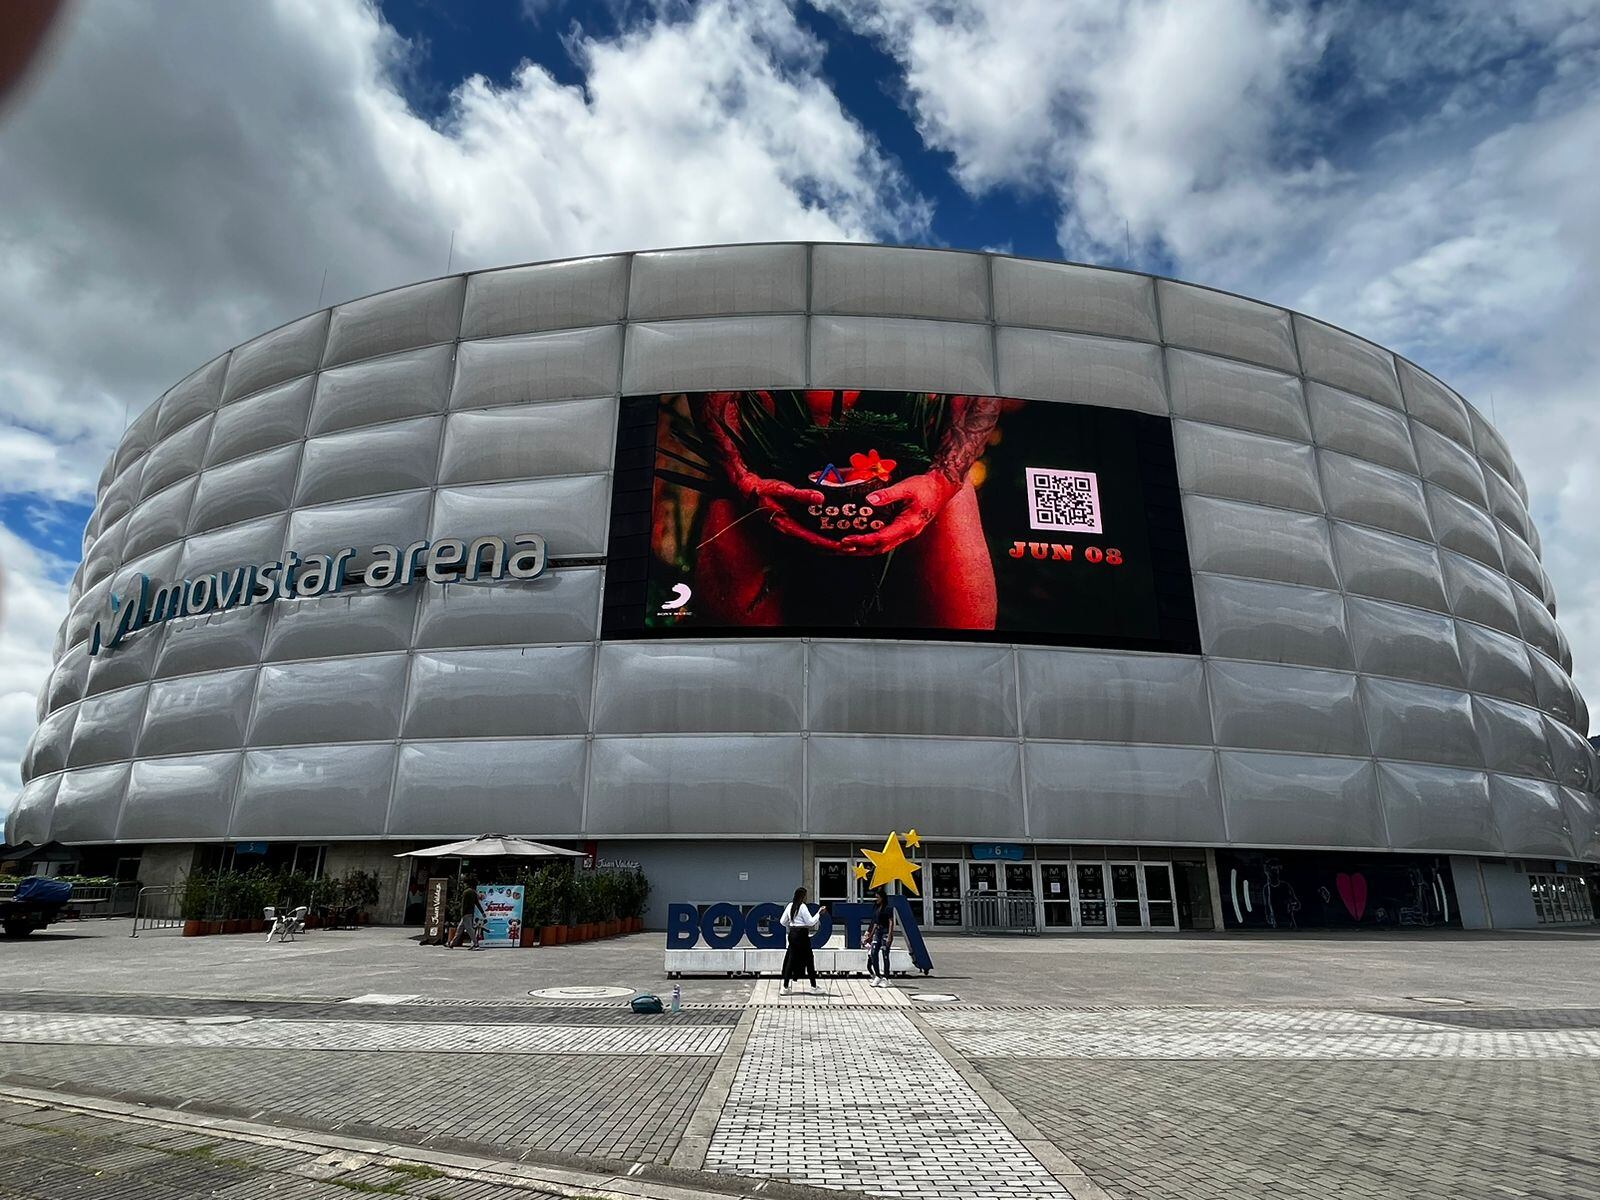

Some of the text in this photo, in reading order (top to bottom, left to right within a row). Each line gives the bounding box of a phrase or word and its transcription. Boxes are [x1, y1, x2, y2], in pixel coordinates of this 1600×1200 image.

[1009, 541, 1123, 565] JUN 08
[149, 533, 548, 622] movistar arena
[994, 846, 1002, 855] 6
